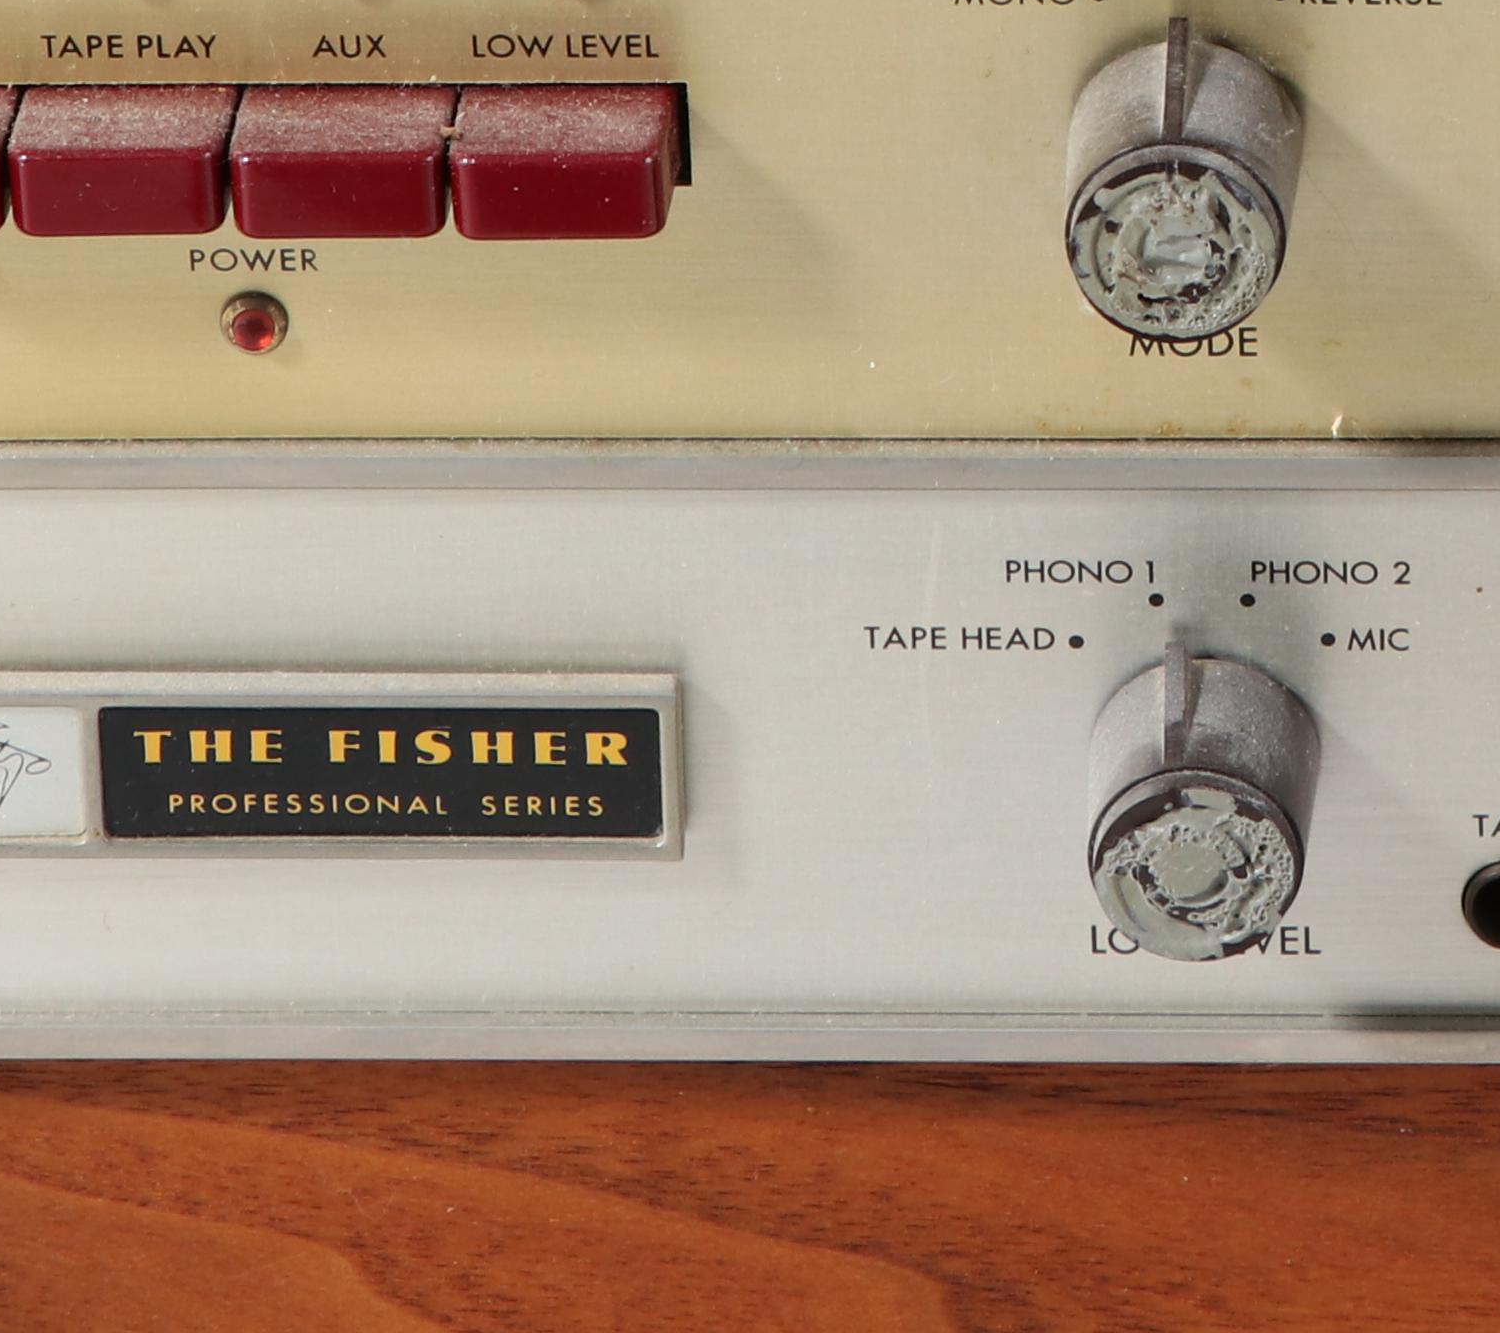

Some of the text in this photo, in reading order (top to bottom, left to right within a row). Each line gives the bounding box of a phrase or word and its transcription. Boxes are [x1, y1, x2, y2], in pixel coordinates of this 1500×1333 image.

[40, 34, 216, 59] TAPE PLAY
[312, 34, 387, 59] AUX
[472, 34, 659, 58] LOW LEVEL
[189, 248, 318, 272] POWER
[1005, 559, 1154, 584] PHONO 1
[1251, 560, 1411, 585] PHONO 2
[863, 626, 1055, 650] TAPE HEAD
[1347, 628, 1409, 652] MIC
[133, 729, 628, 766] THE FISHER
[169, 793, 603, 817] PROFESSIONAL SERIES
